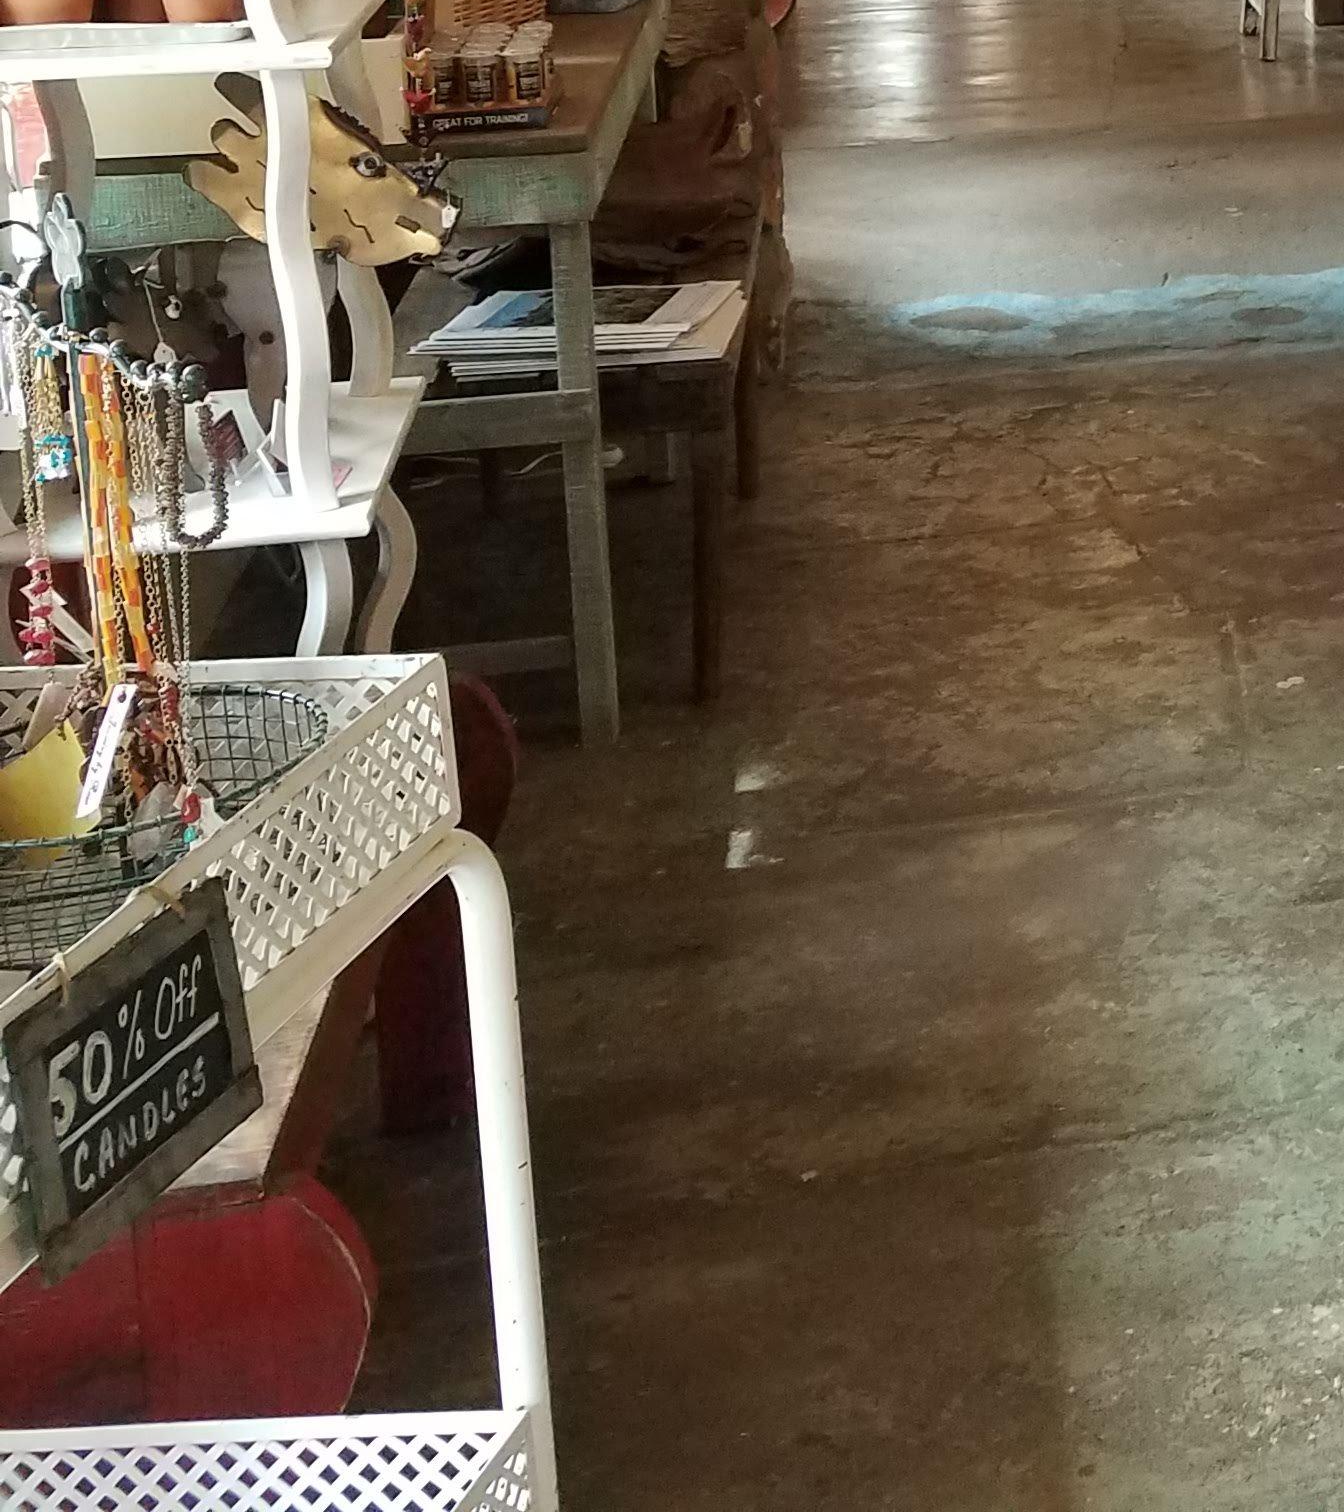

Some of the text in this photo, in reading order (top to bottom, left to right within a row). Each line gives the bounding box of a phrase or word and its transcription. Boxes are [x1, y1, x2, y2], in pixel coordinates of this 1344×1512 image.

[464, 116, 482, 126] FOR
[485, 113, 528, 125] TRAINING!
[49, 954, 202, 1138] 50% Off
[74, 1055, 206, 1193] CANDLES
